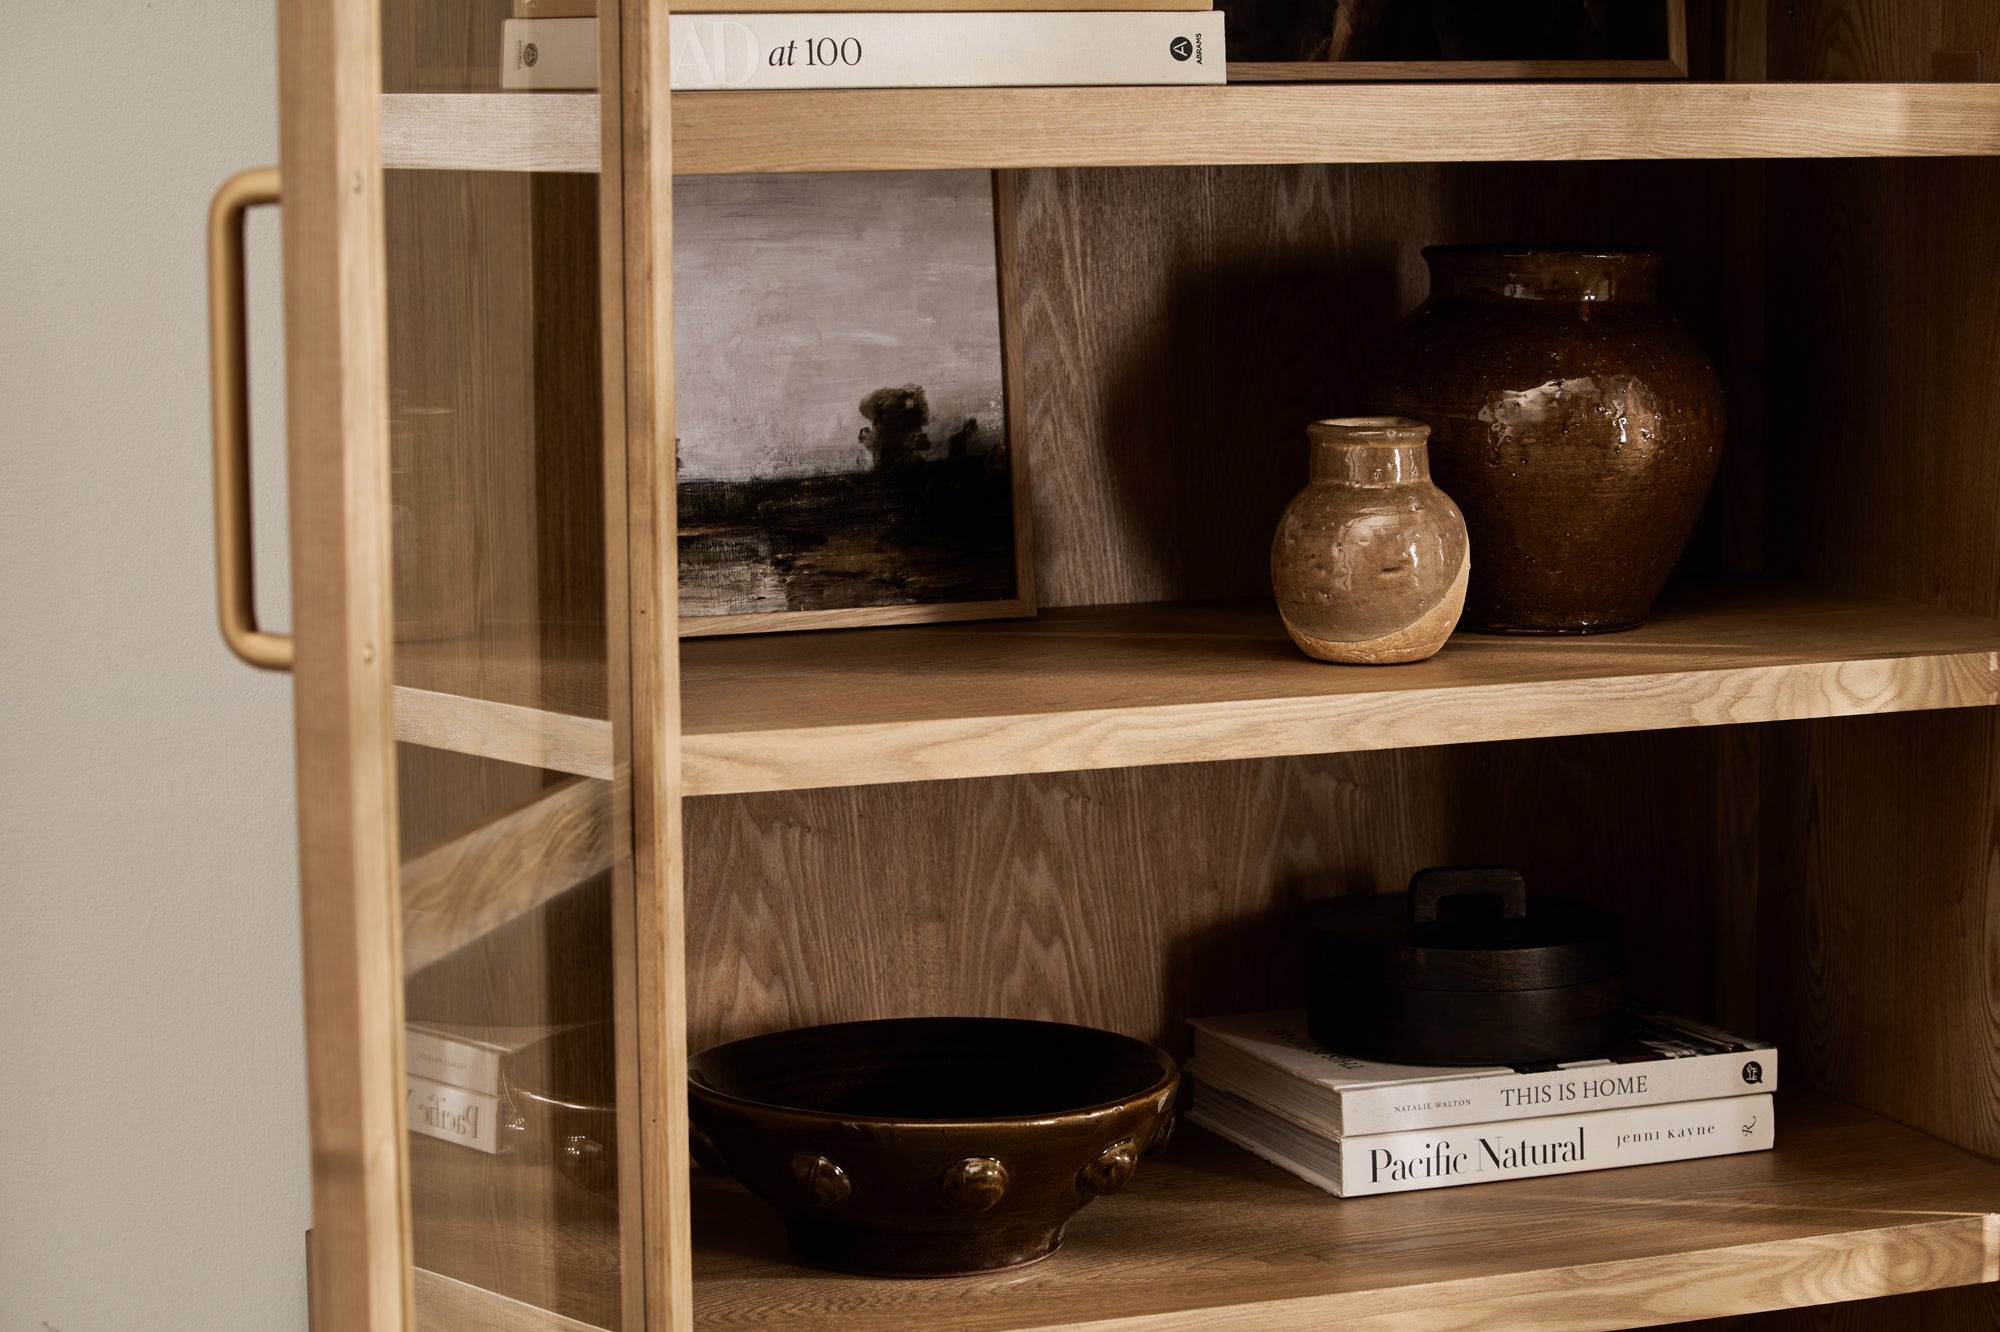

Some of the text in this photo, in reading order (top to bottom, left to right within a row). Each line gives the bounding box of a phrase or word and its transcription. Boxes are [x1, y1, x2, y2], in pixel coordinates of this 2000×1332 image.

[671, 20, 863, 87] AD at 100
[1195, 33, 1203, 65] ABRAMS
[1394, 1099, 1471, 1112] NATALIE WALTON
[1500, 1075, 1649, 1107] THIS IS HOME
[1368, 1127, 1588, 1184] Pacific Natural
